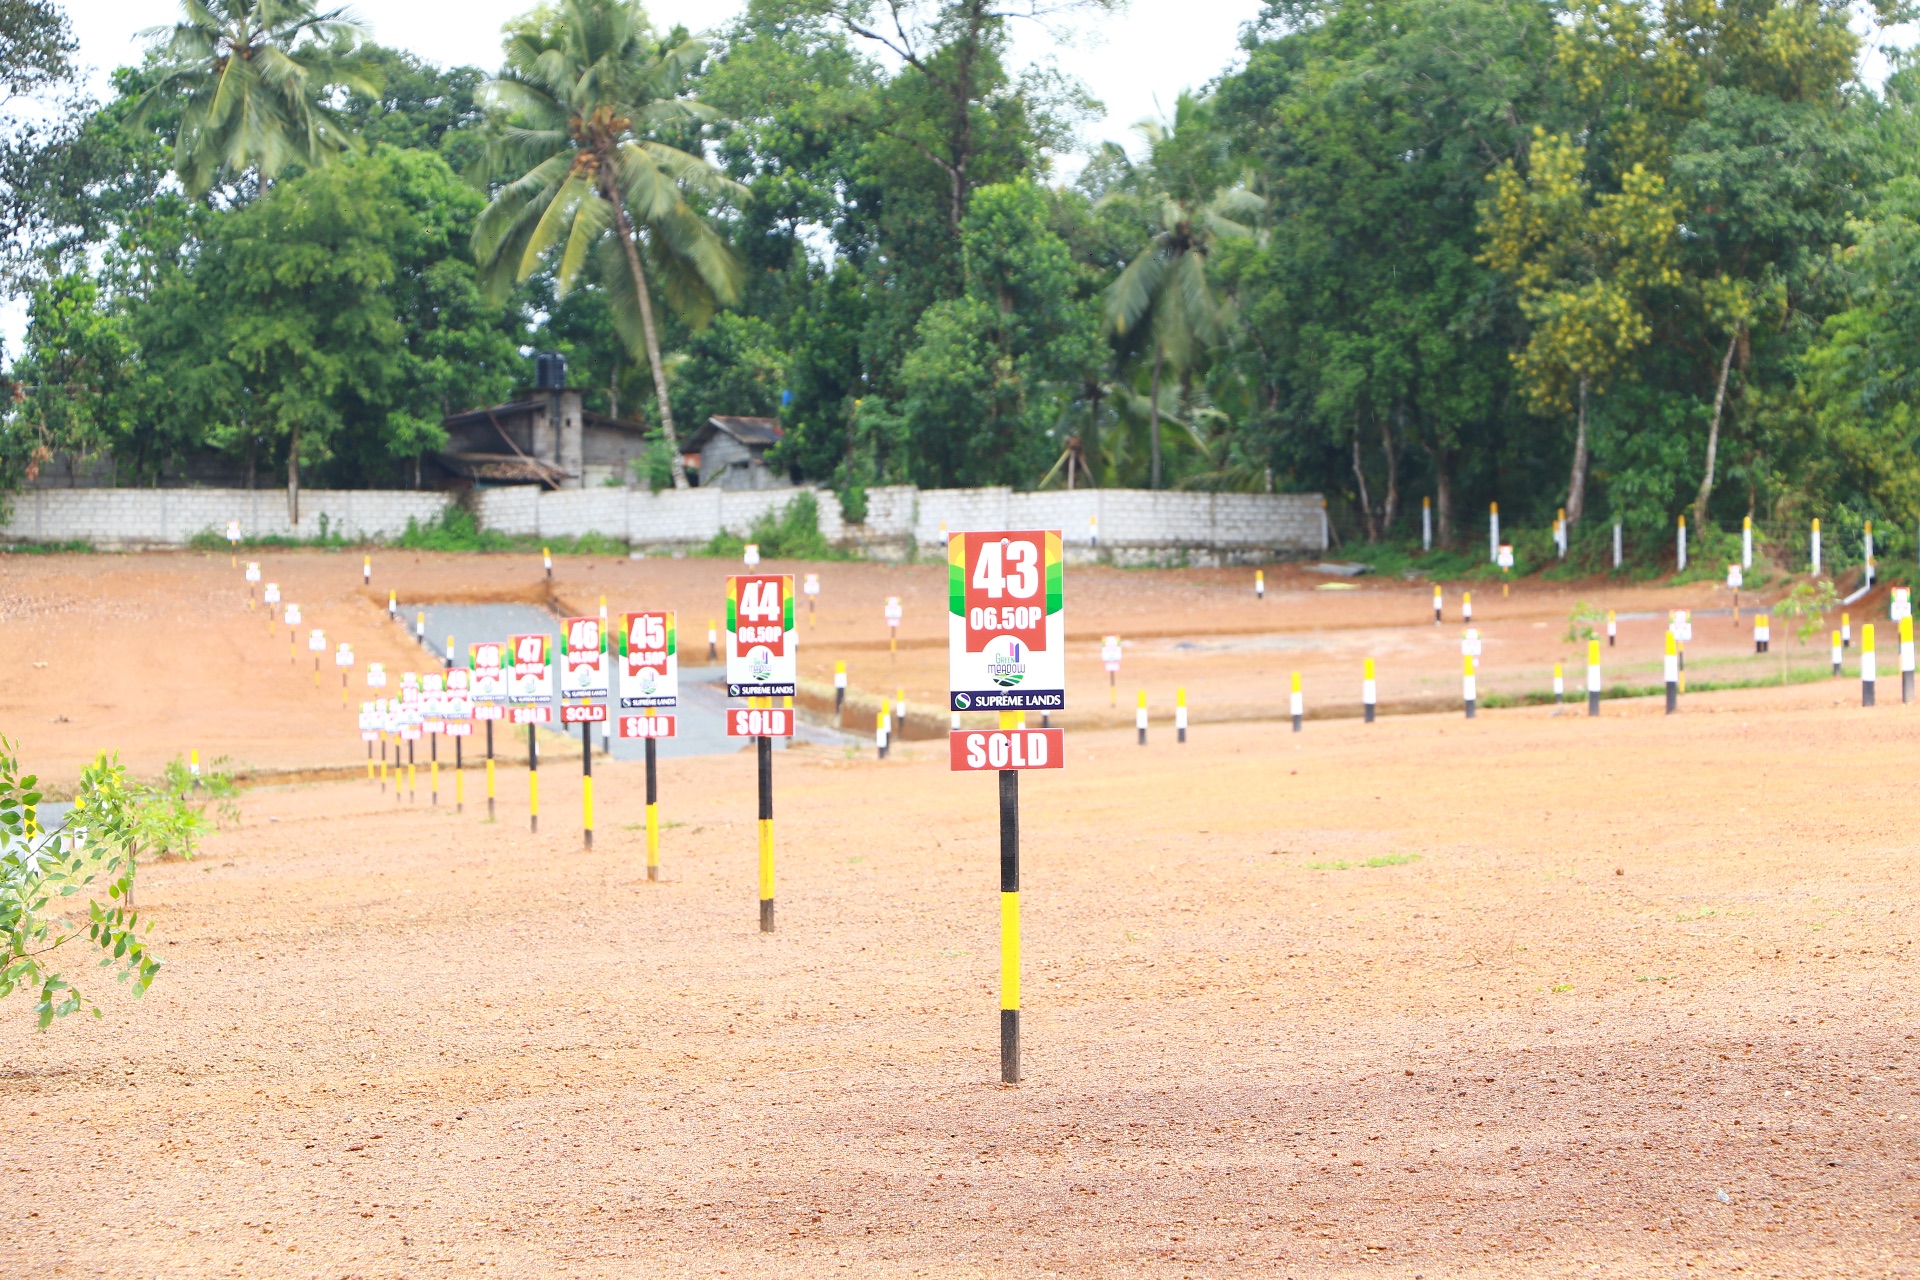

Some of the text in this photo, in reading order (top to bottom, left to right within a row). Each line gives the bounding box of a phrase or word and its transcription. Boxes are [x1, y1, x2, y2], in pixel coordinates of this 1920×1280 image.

[972, 540, 1039, 599] 43
[740, 581, 780, 622] 44
[970, 606, 1042, 630] 06.50P
[569, 621, 598, 650] 46
[630, 616, 665, 649] 45
[738, 626, 782, 643] 06.50P
[517, 638, 541, 663] 47
[741, 686, 794, 694] SUPREME LANDS
[975, 695, 1061, 706] SUPREME LANDS
[475, 706, 502, 719] SOLD
[514, 708, 546, 723] SOLD
[566, 706, 603, 721] SOLD
[736, 710, 785, 735] SOLD
[626, 717, 669, 737] SOLD
[966, 732, 1048, 768] SOLD
